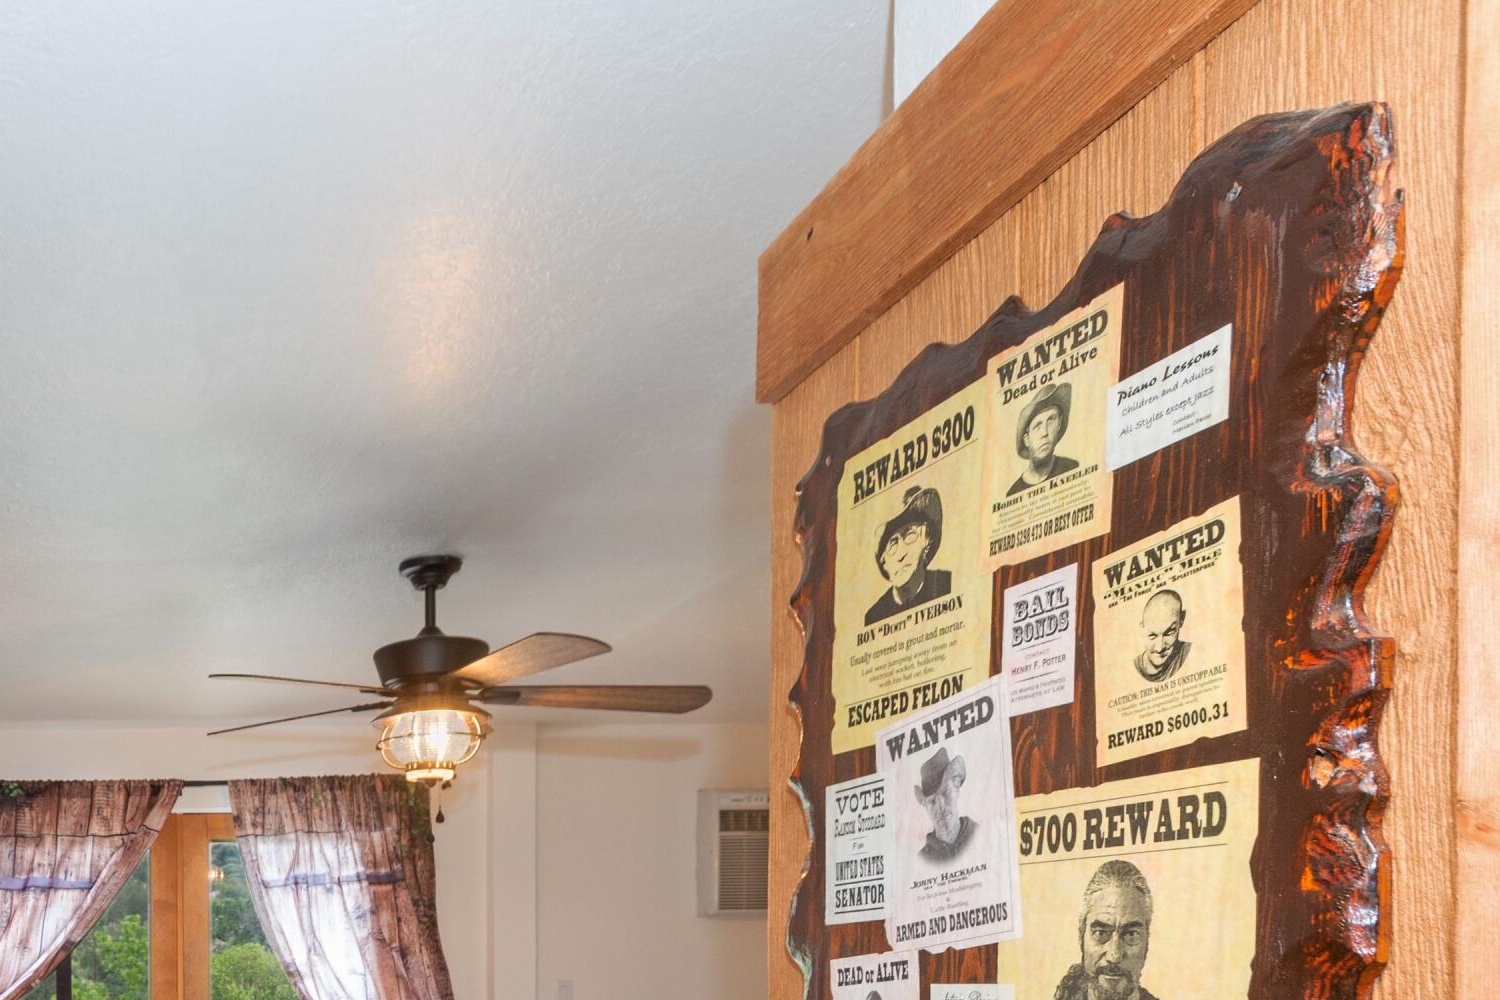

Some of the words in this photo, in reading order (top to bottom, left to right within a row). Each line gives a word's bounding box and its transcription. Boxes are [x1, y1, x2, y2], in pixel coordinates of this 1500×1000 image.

[996, 309, 1108, 388] WANTED
[1002, 376, 1037, 406] Dead
[1040, 368, 1055, 385] or
[1058, 346, 1098, 377] Alive
[1117, 377, 1157, 407] Piano
[1161, 344, 1219, 382] Lessons
[1122, 394, 1159, 416] Children
[1161, 380, 1179, 398] and
[1181, 365, 1214, 385] Adults
[1119, 426, 1133, 438] All
[1134, 410, 1164, 429] Styles
[1165, 396, 1192, 415] except
[853, 433, 928, 505] REWARD
[931, 404, 975, 459] $300
[989, 532, 1016, 557] REWARD
[1043, 519, 1053, 537] OR
[1053, 512, 1071, 534] BEST
[1071, 503, 1094, 527] OFFER
[1103, 518, 1225, 589] WANTED
[1013, 586, 1069, 624] BAIL
[873, 644, 898, 660] covered
[925, 627, 938, 641] and
[1012, 609, 1069, 647] BONDS
[1011, 664, 1033, 676] HENRY
[1042, 653, 1067, 668] POTTER
[1140, 687, 1154, 699] THIS
[1154, 683, 1169, 694] MAN
[1169, 680, 1177, 689] IS
[1177, 663, 1228, 686] UNSTOPPABLE
[848, 691, 909, 728] ESCAPED
[912, 674, 964, 710] FELON
[885, 695, 994, 763] WANTED
[1108, 720, 1164, 750] REWARD
[1167, 701, 1229, 733] $6000.31
[835, 786, 884, 816] VOTE
[1019, 812, 1077, 856] $700
[1083, 791, 1227, 850] REWARD
[835, 859, 858, 881] UNITED
[859, 855, 884, 878] STATES
[909, 876, 938, 890] JONNY
[940, 863, 987, 881] HACKMAN
[835, 883, 885, 908] SENATOR
[896, 920, 927, 943] ARMED
[928, 915, 947, 936] AND
[949, 901, 1008, 932] DANGEROUS
[837, 966, 863, 987] DEAD
[865, 970, 874, 983] or
[876, 960, 909, 982] ALIVE
